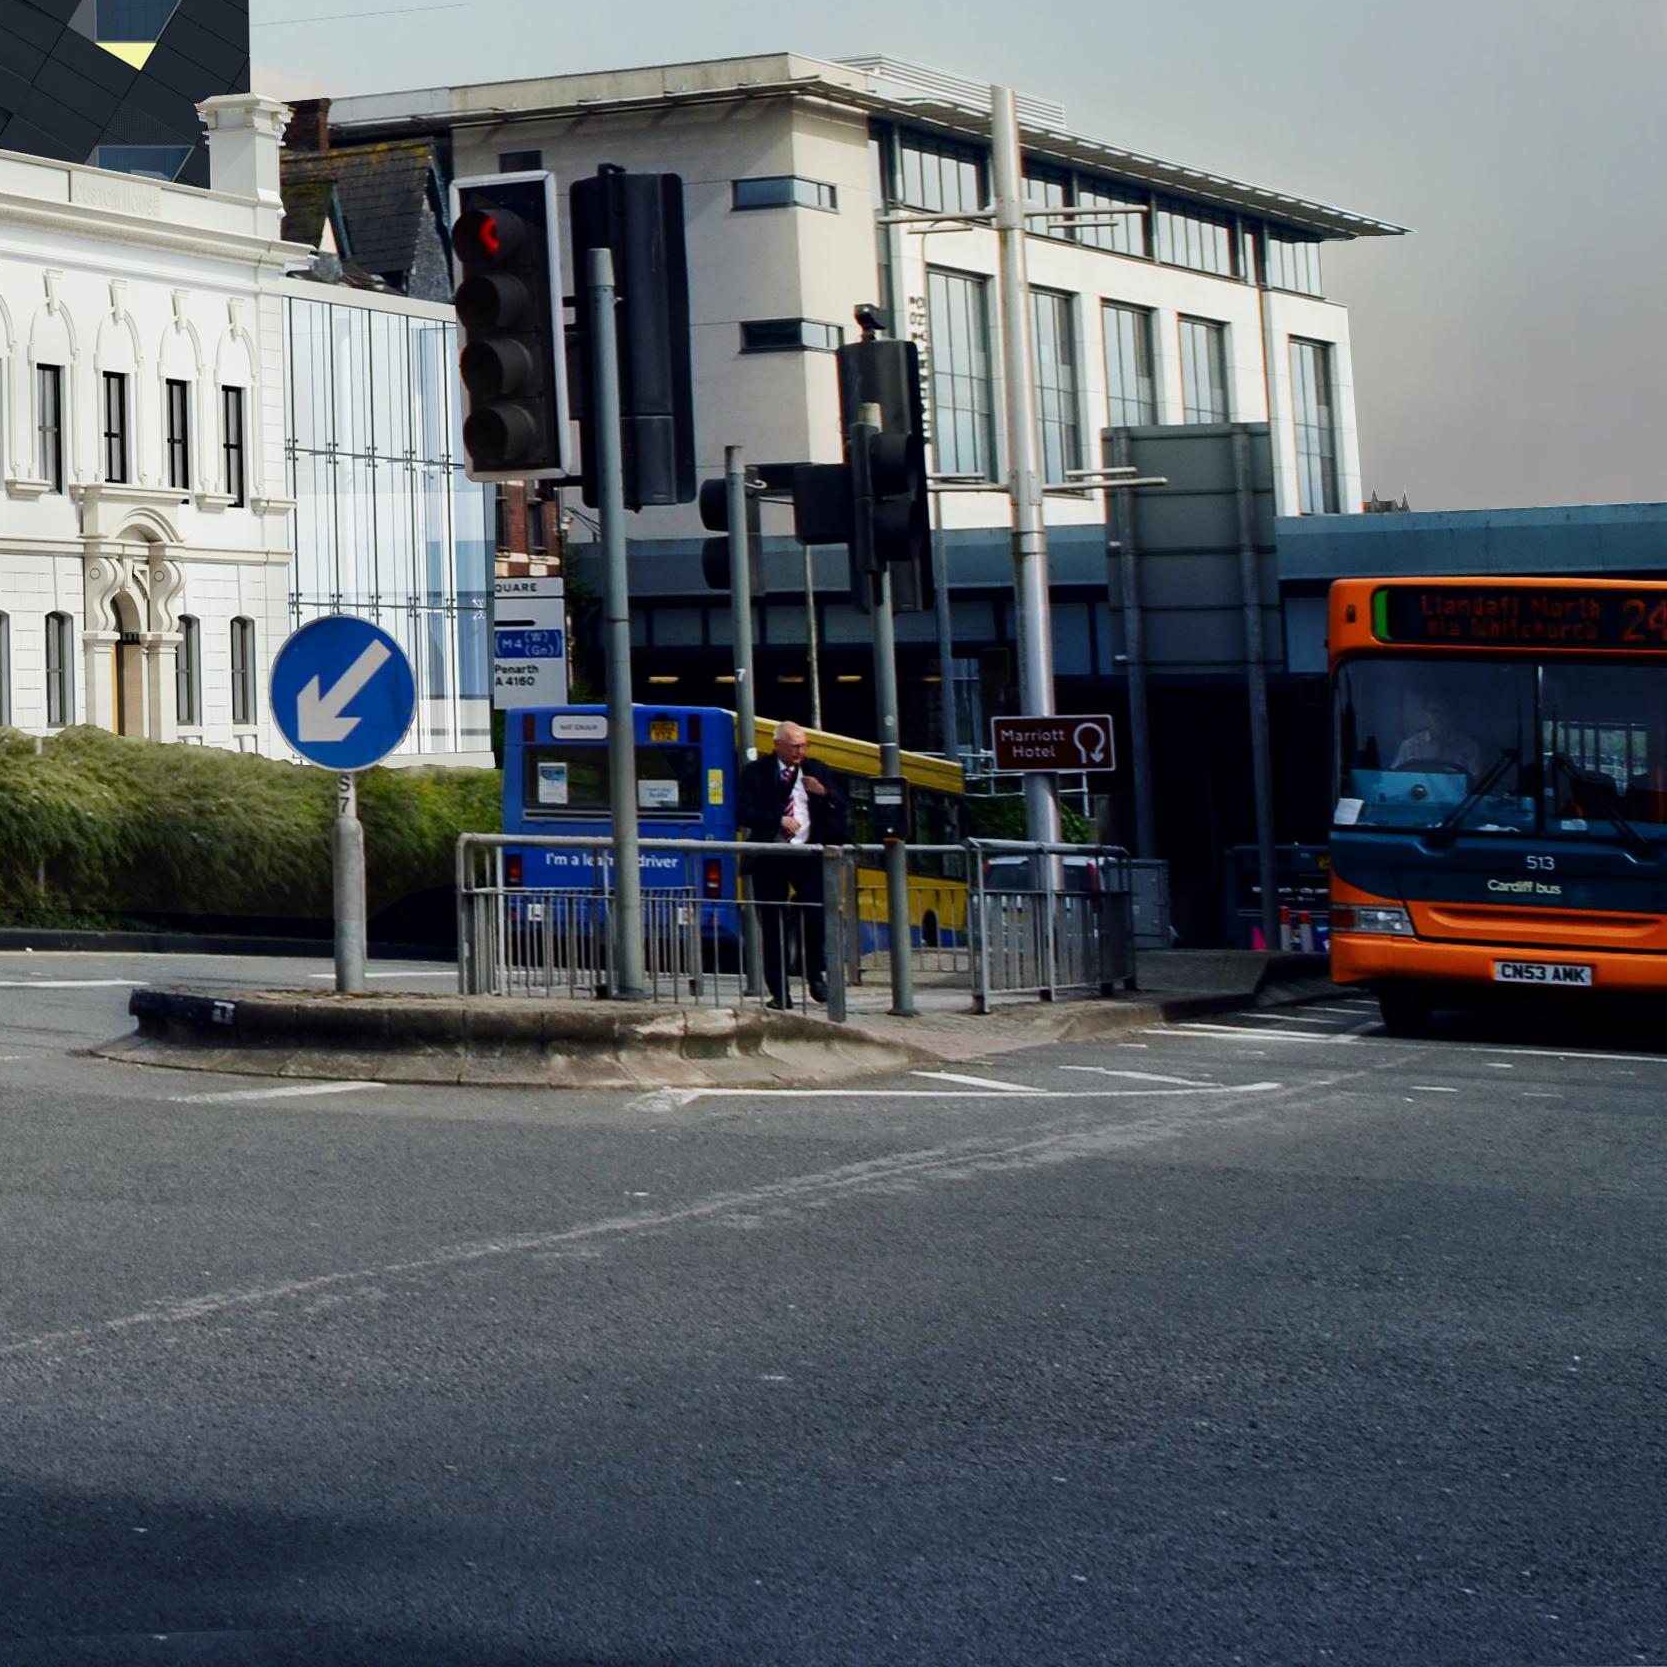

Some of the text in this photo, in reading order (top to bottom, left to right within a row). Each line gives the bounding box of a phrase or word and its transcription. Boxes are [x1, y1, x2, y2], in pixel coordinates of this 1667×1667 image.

[495, 583, 537, 593] QUARE
[1421, 594, 1520, 616] Llandaff
[1530, 596, 1602, 618] North
[495, 664, 539, 674] Penarth
[1001, 729, 1066, 742] Marriott
[1012, 746, 1056, 758] Hotel
[338, 774, 350, 792] S
[339, 797, 350, 813] 7
[545, 852, 567, 865] I'm
[571, 855, 580, 866] a
[637, 854, 679, 868] driver
[1526, 855, 1555, 870] 513
[1487, 879, 1562, 895] Cardiff bus
[1500, 964, 1586, 983] CN53 AMK
